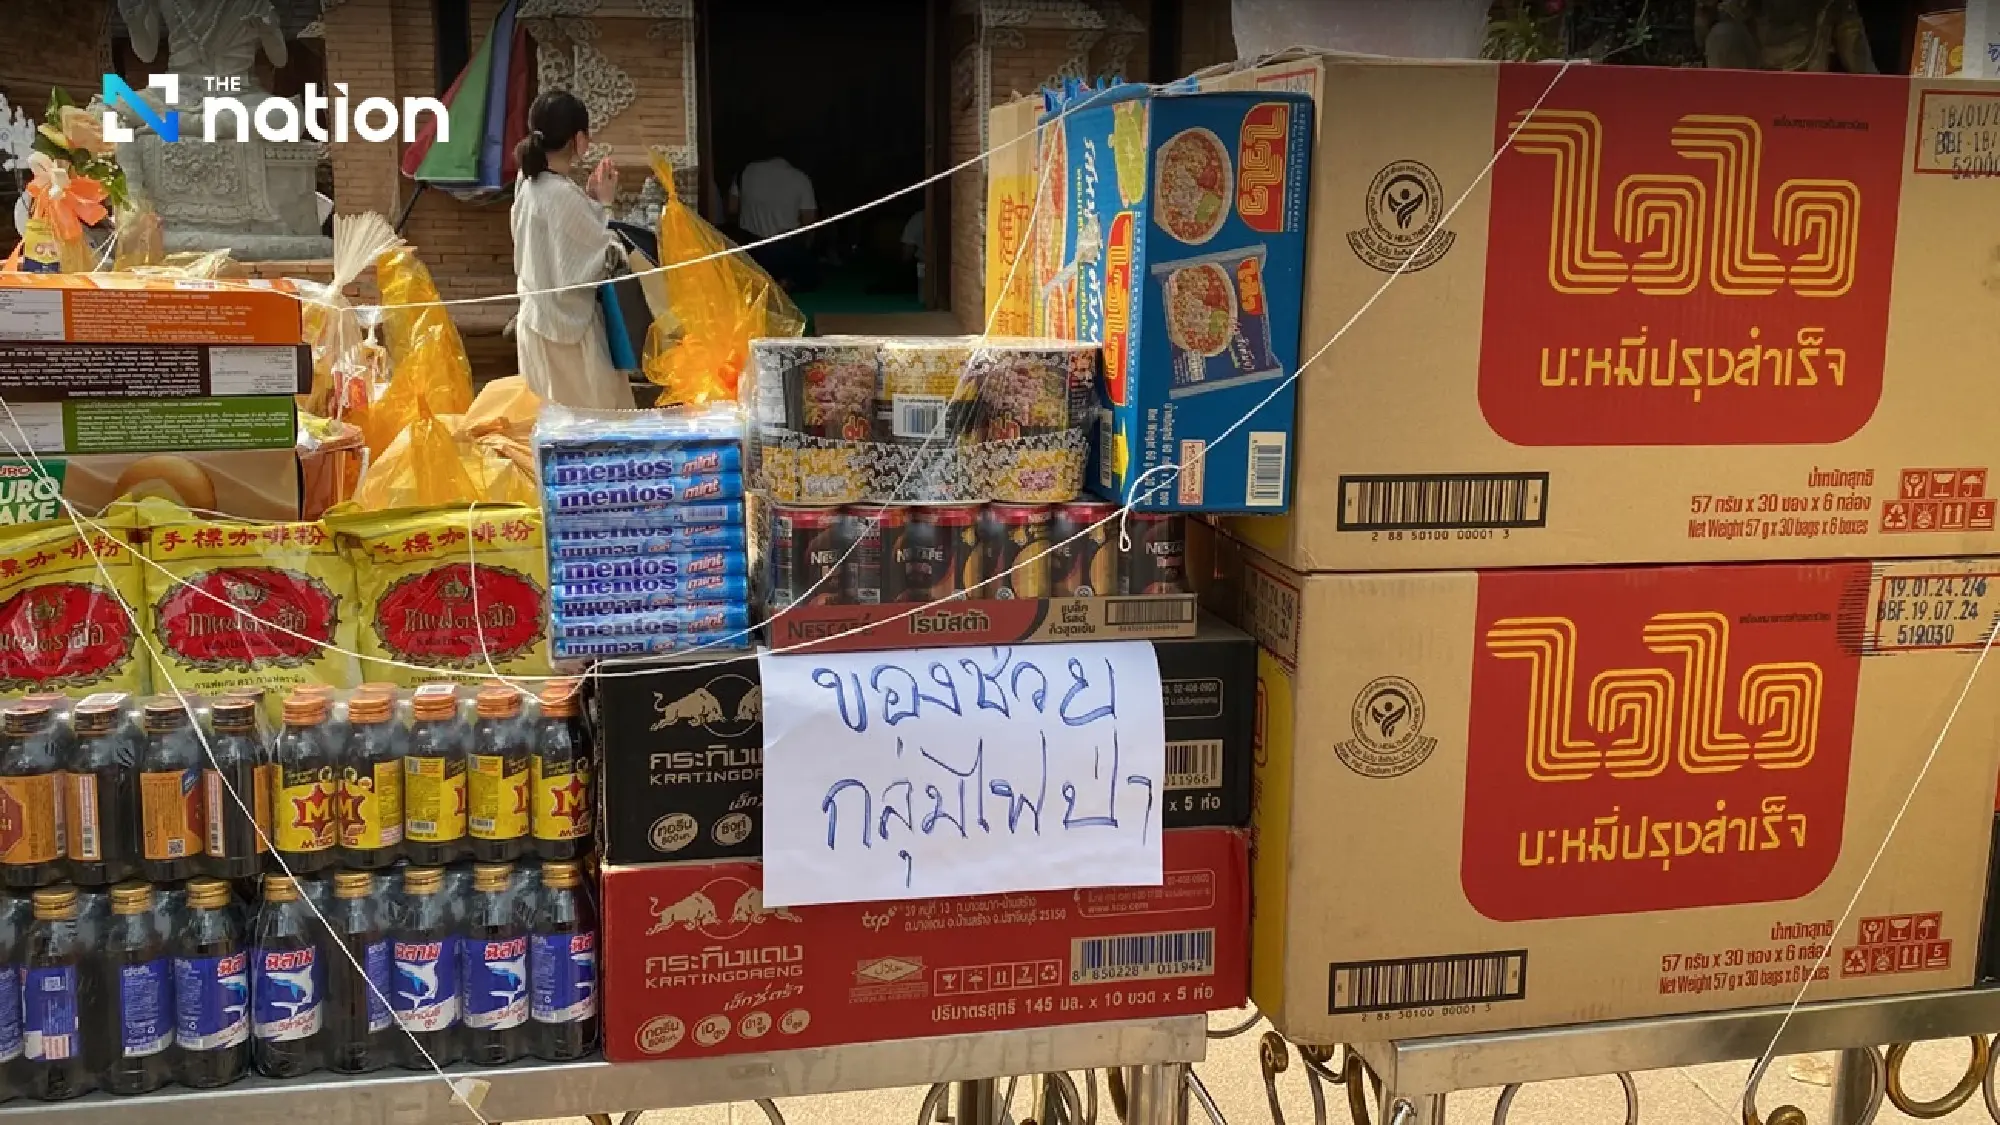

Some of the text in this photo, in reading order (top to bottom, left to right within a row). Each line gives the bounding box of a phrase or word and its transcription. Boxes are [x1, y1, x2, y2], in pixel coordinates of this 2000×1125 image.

[1540, 326, 1846, 403] บะหมี่ปรุงสำเร็จ
[555, 459, 673, 485] mentos
[0, 477, 60, 504] URO
[558, 484, 675, 508] mentos
[0, 501, 55, 525] AKE
[1691, 495, 1711, 513] 57
[1745, 499, 1754, 512] x
[1757, 494, 1777, 513] 30
[1811, 498, 1819, 511] x
[1822, 493, 1833, 511] 6
[1371, 531, 1379, 542] 2
[1388, 531, 1403, 541] 88
[1411, 530, 1449, 541] 50100
[1503, 529, 1510, 540] 3
[1688, 520, 1706, 538] Net
[1708, 519, 1744, 540] Weight
[1745, 519, 1760, 537] 57
[1762, 523, 1769, 540] g
[1778, 518, 1794, 536] 30
[1795, 518, 1819, 538] bags
[1829, 518, 1838, 535] 6
[1838, 517, 1868, 535] boxes
[562, 557, 678, 580] mentos
[565, 618, 680, 637] mentos
[908, 609, 989, 635] โรบัสต้า
[650, 744, 763, 771] กระทิงแ
[650, 768, 763, 786] KRATINGDA
[1169, 801, 1178, 811] x
[1184, 796, 1193, 811] 5
[1518, 796, 1808, 872] บะหมี่ปรุงสำเร็จ
[1662, 954, 1682, 972] 57
[1712, 954, 1721, 967] x
[1725, 950, 1743, 968] 30
[1774, 950, 1783, 963] x
[1786, 944, 1796, 961] 6
[645, 964, 803, 989] KRATINGDAENG
[1072, 970, 1080, 981] 8
[1092, 965, 1139, 981] 850228
[1659, 976, 1676, 994] Net
[1678, 973, 1712, 995] Weight
[1713, 972, 1727, 991] 57
[1745, 969, 1758, 987] 30
[1792, 966, 1800, 982] 6
[1025, 996, 1053, 1013] 145
[1088, 998, 1098, 1009] x
[1105, 992, 1122, 1006] 10
[1162, 992, 1171, 1002] x
[1177, 985, 1187, 1000] 5
